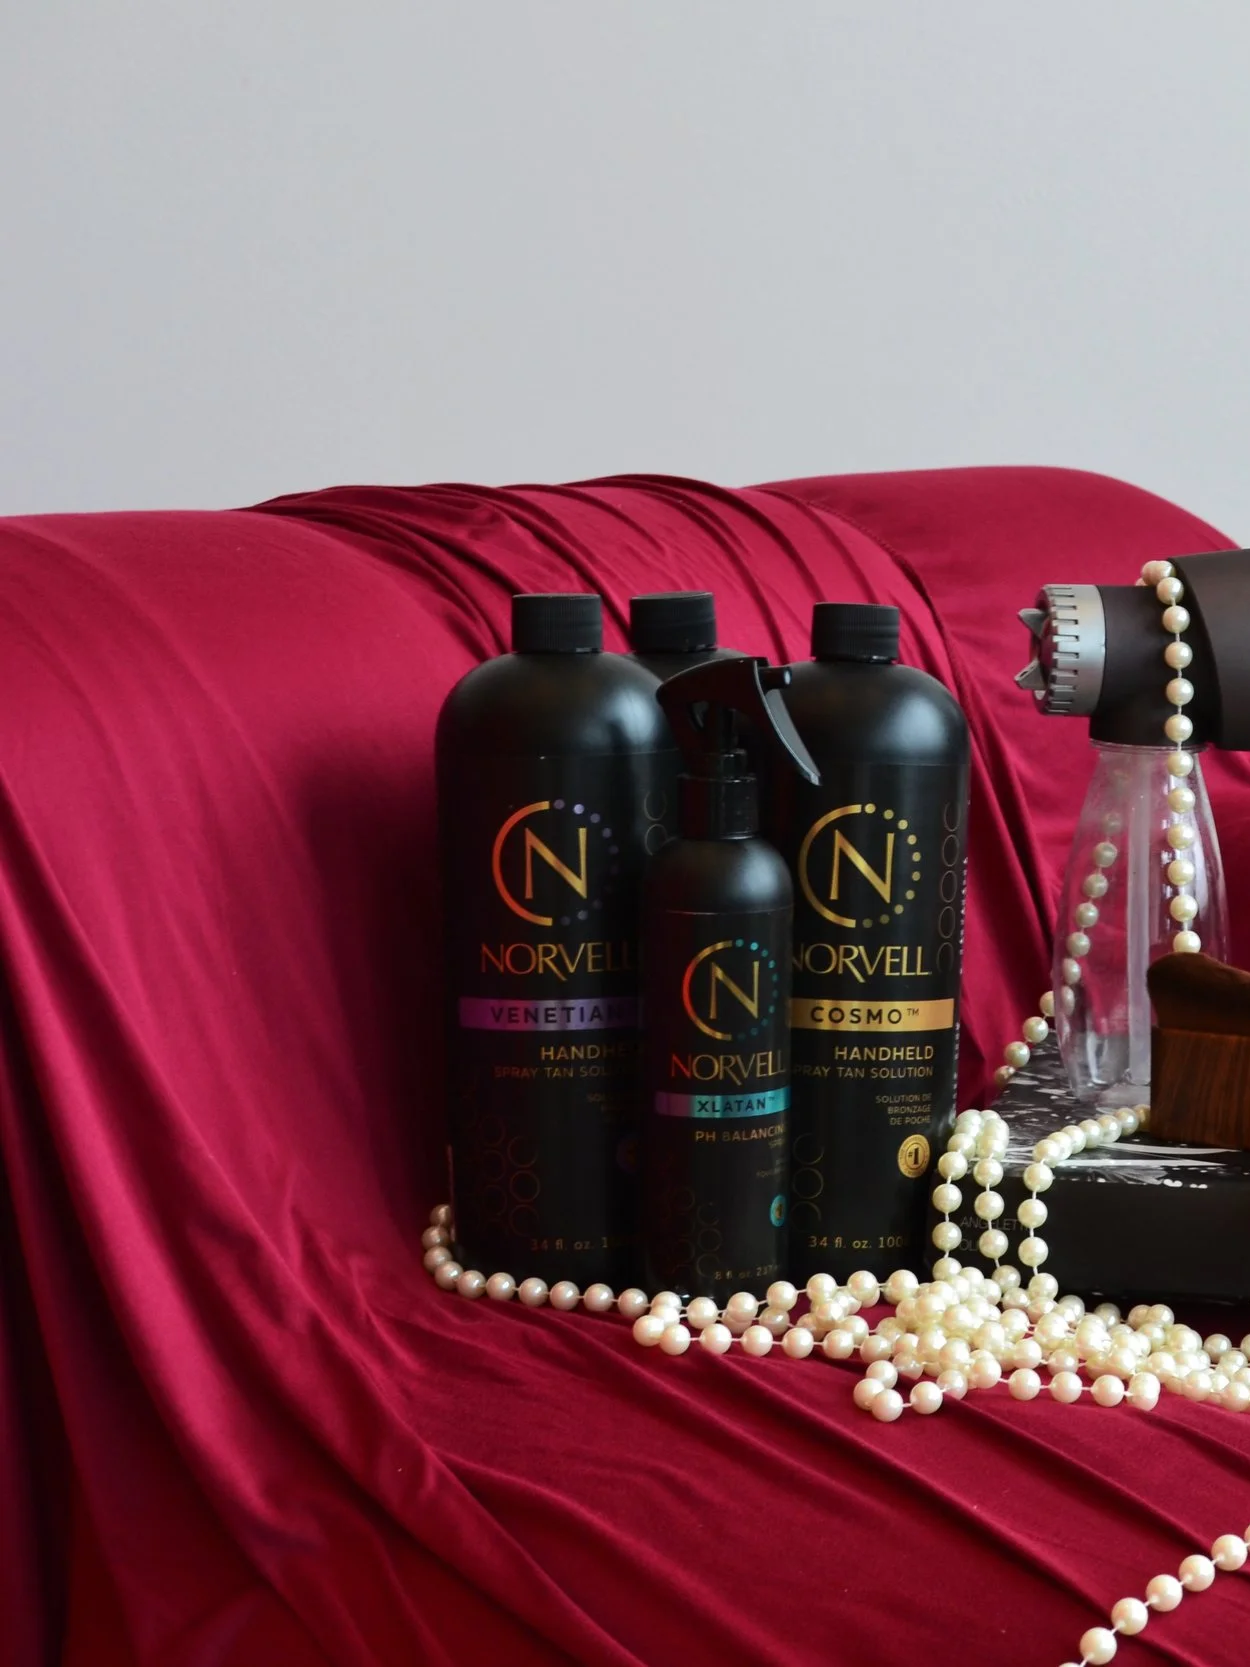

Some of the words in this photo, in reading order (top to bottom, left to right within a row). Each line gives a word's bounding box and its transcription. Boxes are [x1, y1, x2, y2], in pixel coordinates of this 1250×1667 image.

[491, 1006, 622, 1023] VENETIAN
[540, 1045, 632, 1061] HANDHE
[834, 1045, 935, 1061] HANDHELD
[493, 1065, 538, 1080] SPRAY
[543, 1066, 574, 1078] TAN
[671, 1049, 787, 1086] NORVELL
[793, 1065, 831, 1077] PRAY
[836, 1066, 866, 1079] TAN
[870, 1066, 935, 1079] SOLUTION
[876, 1093, 921, 1104] SOLUTION
[887, 1103, 931, 1115] BRONZAGE
[890, 1116, 903, 1126] DE
[906, 1115, 932, 1126] POCHE
[695, 1130, 716, 1142] PH
[530, 1238, 549, 1252] 34
[808, 1235, 828, 1248] 34
[852, 1239, 872, 1249] oz.
